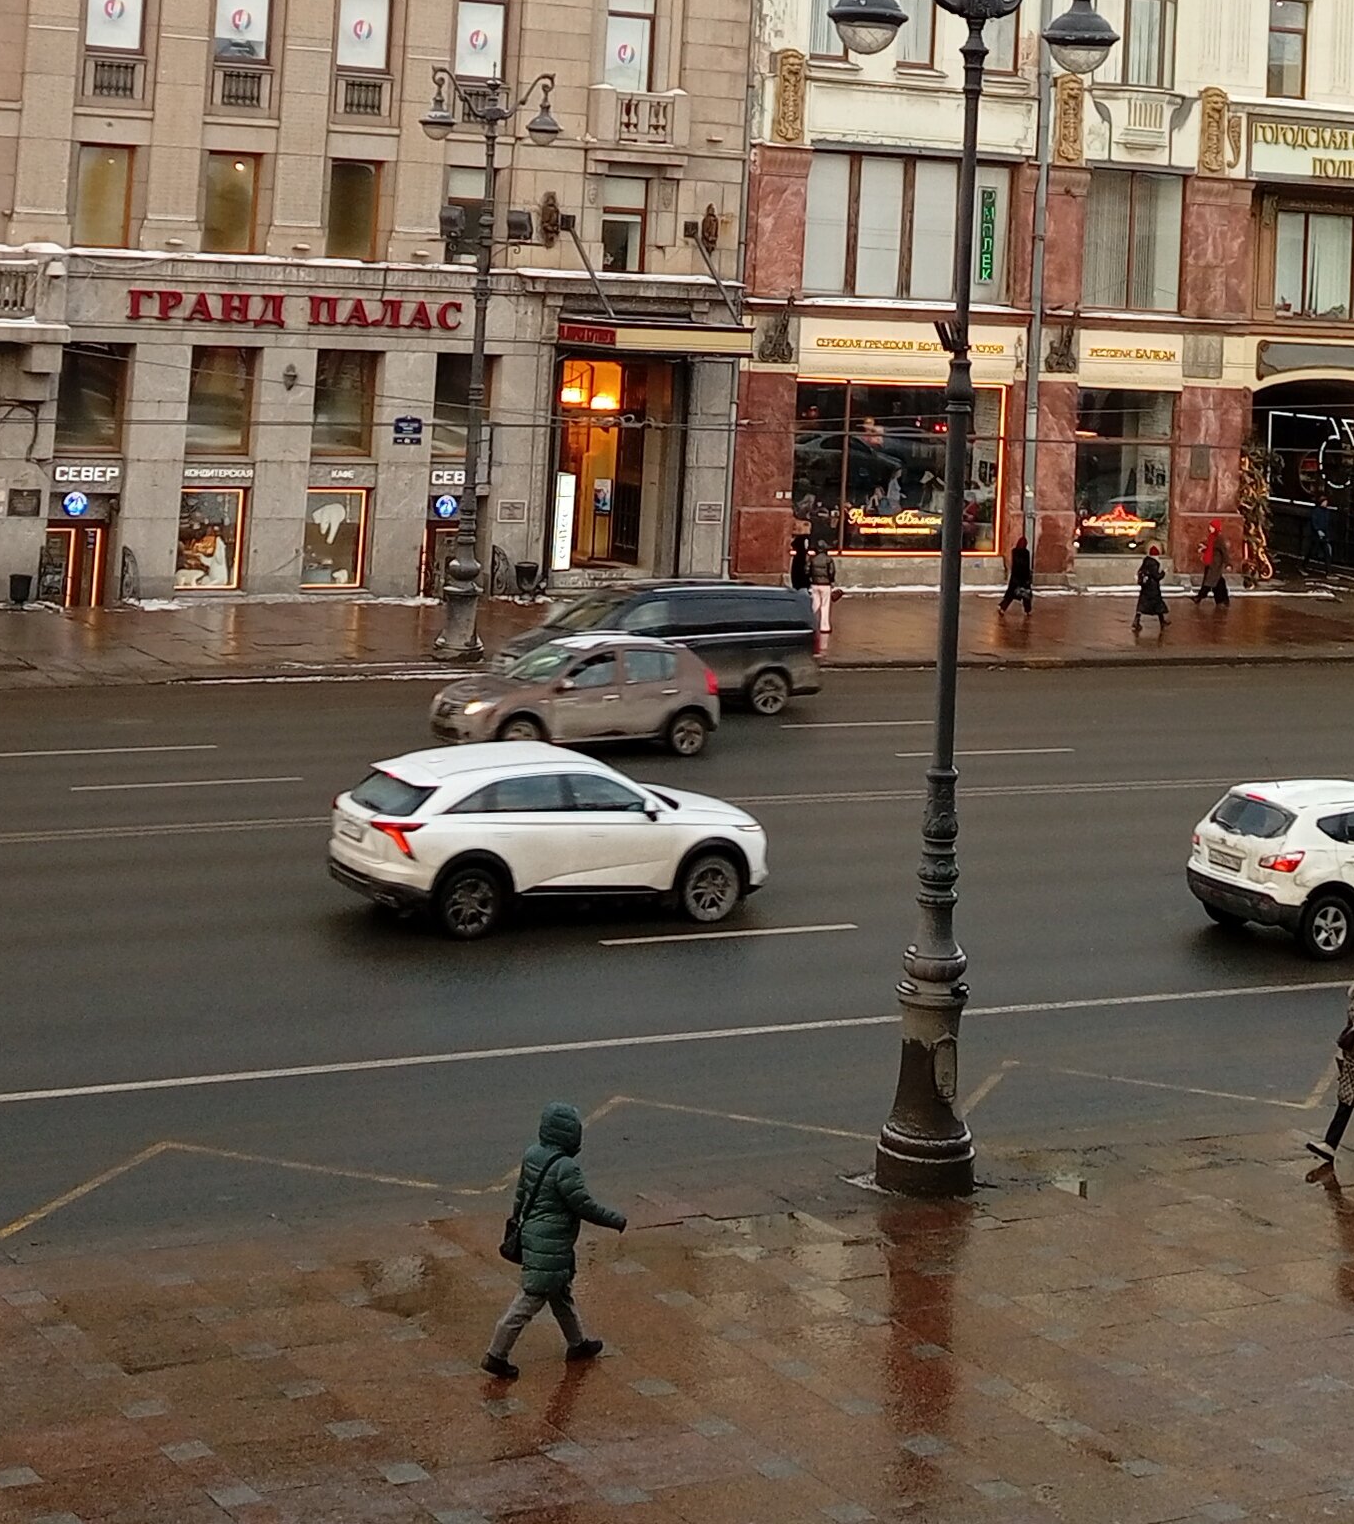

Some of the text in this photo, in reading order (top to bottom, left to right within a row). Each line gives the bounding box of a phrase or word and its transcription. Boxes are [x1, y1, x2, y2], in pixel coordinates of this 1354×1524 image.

[1253, 122, 1349, 151] ГОРОДСКАЯ
[126, 287, 464, 332] ГРАНД ПАЛАС
[1135, 348, 1176, 361] БАЛКАН
[55, 466, 120, 482] СЕВЕР
[184, 468, 254, 478] КОНДИТЕРСКАЯ
[331, 469, 355, 479] КАФЕ
[431, 470, 466, 485] СЕВ
